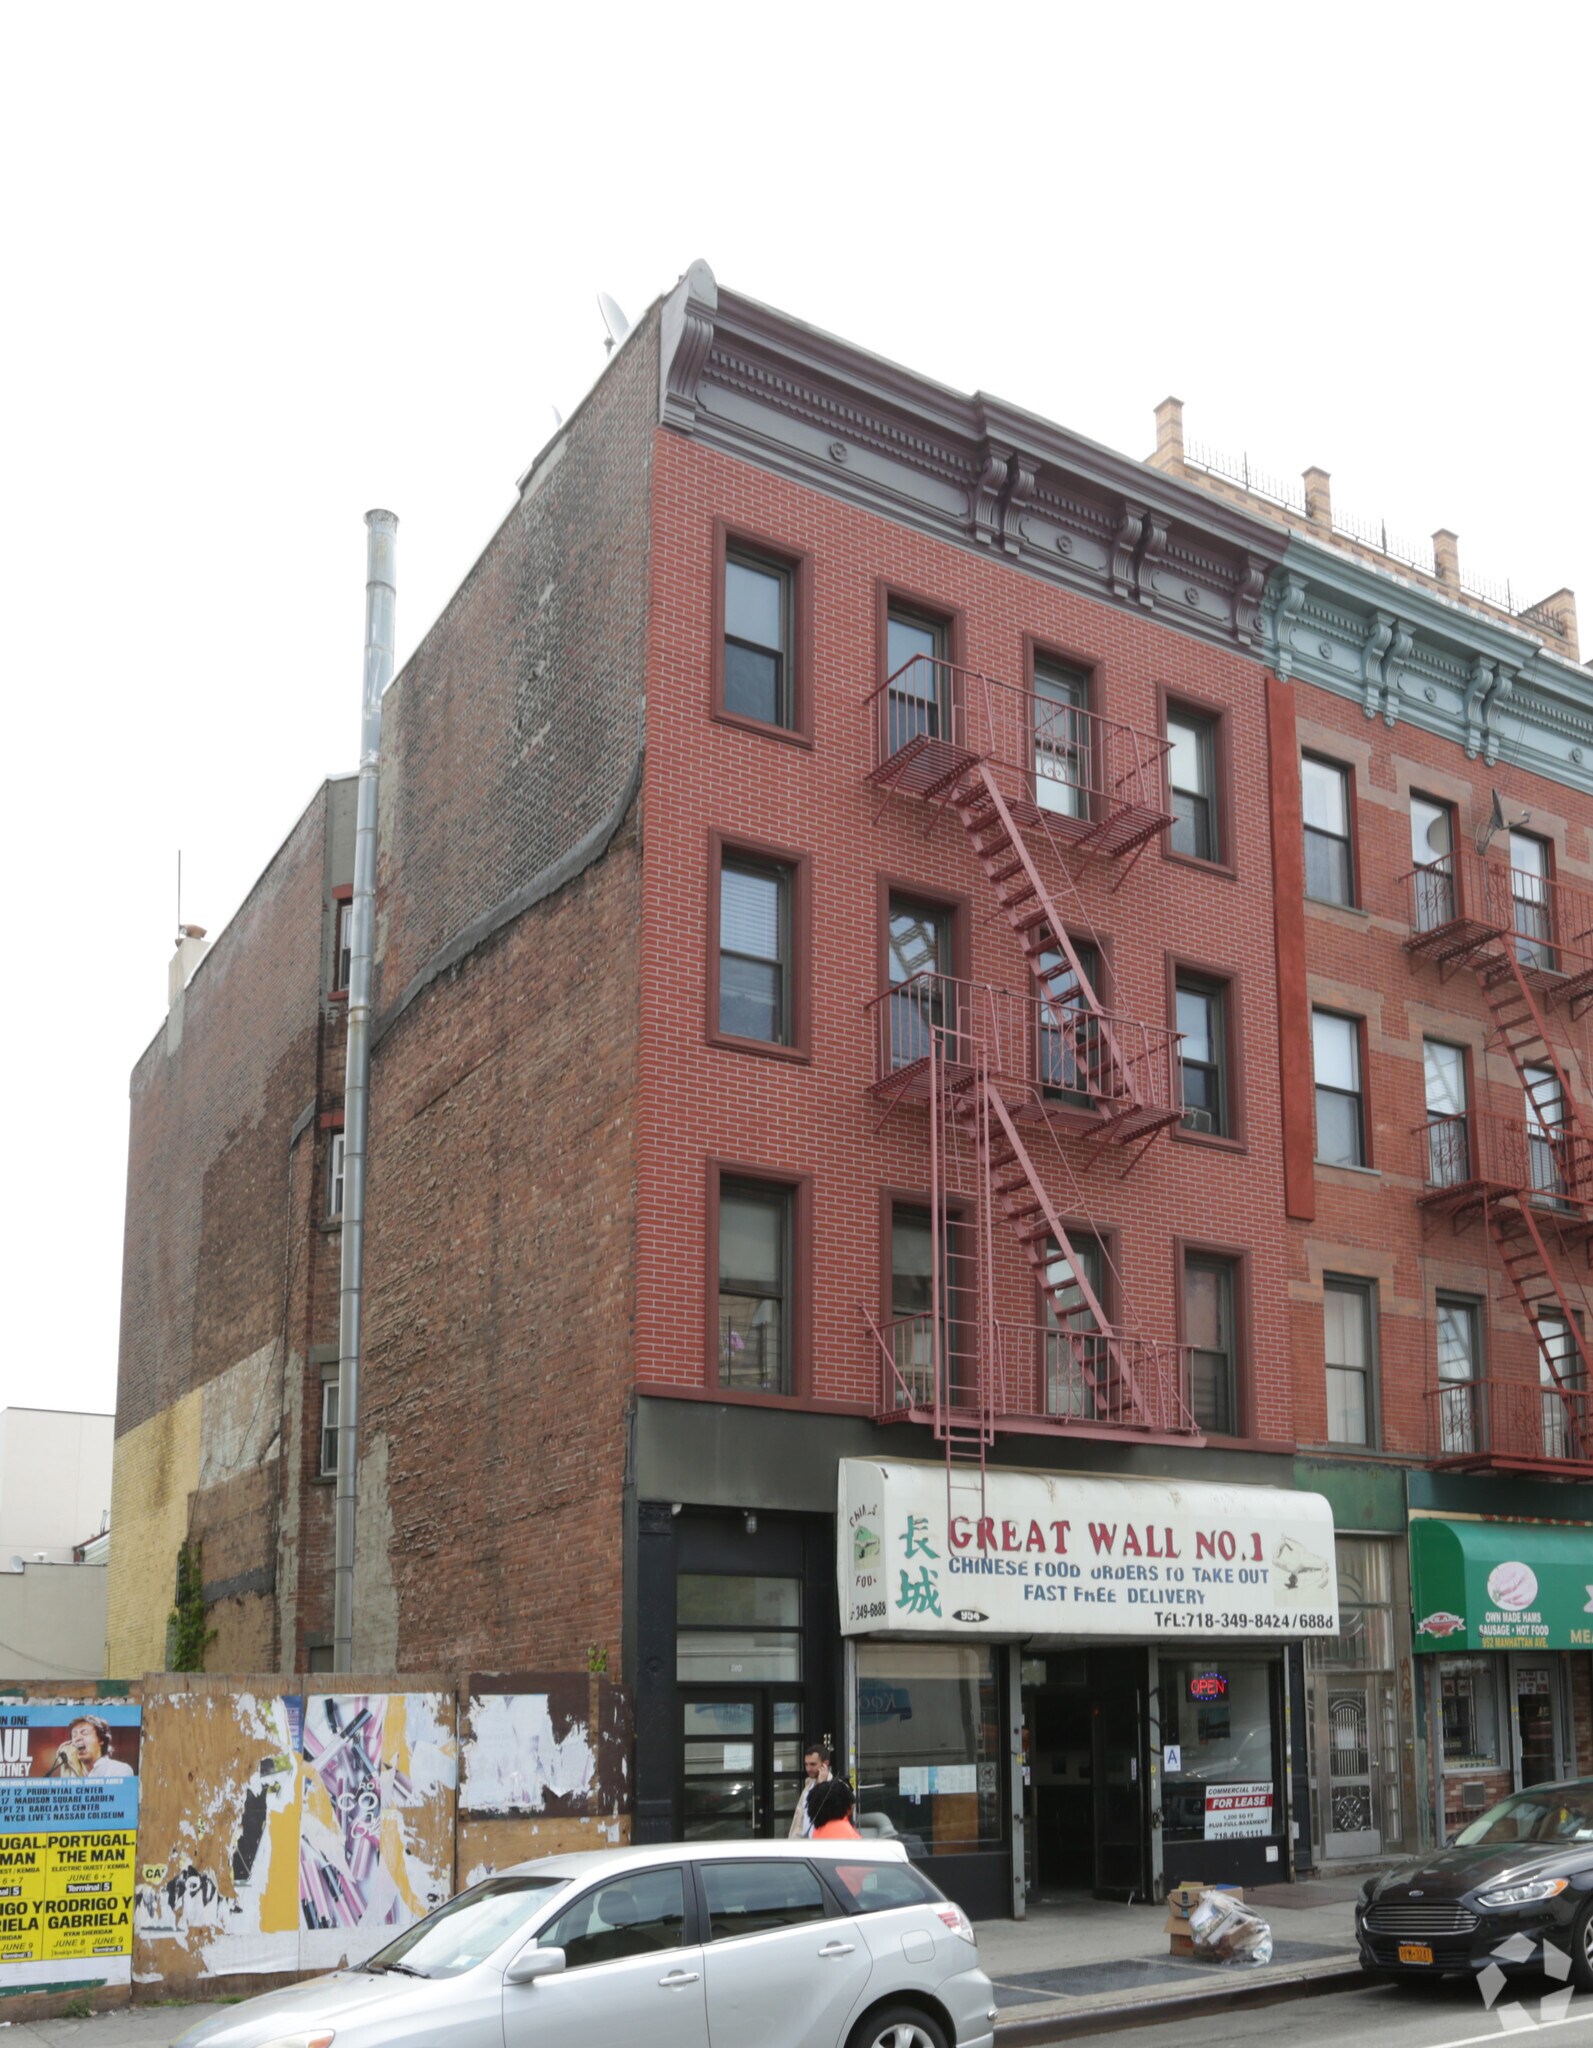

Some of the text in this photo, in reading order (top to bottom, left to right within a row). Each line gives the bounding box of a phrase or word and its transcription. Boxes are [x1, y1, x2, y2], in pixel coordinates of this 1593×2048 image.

[950, 1515, 1071, 1554] GREAT
[1088, 1522, 1182, 1559] WALL
[895, 1515, 942, 1618] 長城
[948, 1556, 1029, 1577] CHINESE
[1034, 1561, 1081, 1578] FOOD
[1192, 1567, 1234, 1584] TAKE
[1238, 1568, 1270, 1584] OUT
[1023, 1584, 1068, 1601] FAST
[1127, 1588, 1206, 1605] DELIVERY
[1485, 1612, 1541, 1623] OWN MADE HAMS
[1478, 1624, 1549, 1636] SAUSAGE HOT FOOD
[1495, 1637, 1533, 1648] MANHATTAN
[1190, 1679, 1225, 1695] OPEN
[11, 1716, 29, 1726] ONE
[1167, 1749, 1178, 1764] A
[27, 1787, 72, 1796] PRUDENTIAL
[75, 1786, 104, 1794] CENTER
[1208, 1785, 1271, 1796] COMMERCIAL SPACE
[15, 1796, 51, 1805] MADISON
[52, 1795, 82, 1804] SQUARE
[84, 1794, 115, 1803] GARDEN
[1212, 1795, 1267, 1810] FOR LEASE
[29, 1804, 70, 1812] BARCLAYS
[72, 1803, 100, 1811] CENTER
[4, 1814, 26, 1823] NYCB
[53, 1812, 86, 1821] NASSAU
[87, 1811, 125, 1820] COLISEUM
[48, 1833, 136, 1849] PORTUGAL.
[57, 1848, 126, 1864] THE MAN
[51, 1865, 82, 1873] ELECTRIC
[67, 1873, 92, 1882] JUNE
[67, 1882, 110, 1893] Terminal 5
[32, 1900, 43, 1914] Y
[45, 1896, 133, 1914] RODRIGO Y
[48, 1912, 129, 1930] GABRIELA
[82, 1928, 113, 1936] SHERIDAN
[2, 1943, 26, 1951] JUNE
[53, 1939, 78, 1948] JUNE
[92, 1937, 116, 1946] JUNE
